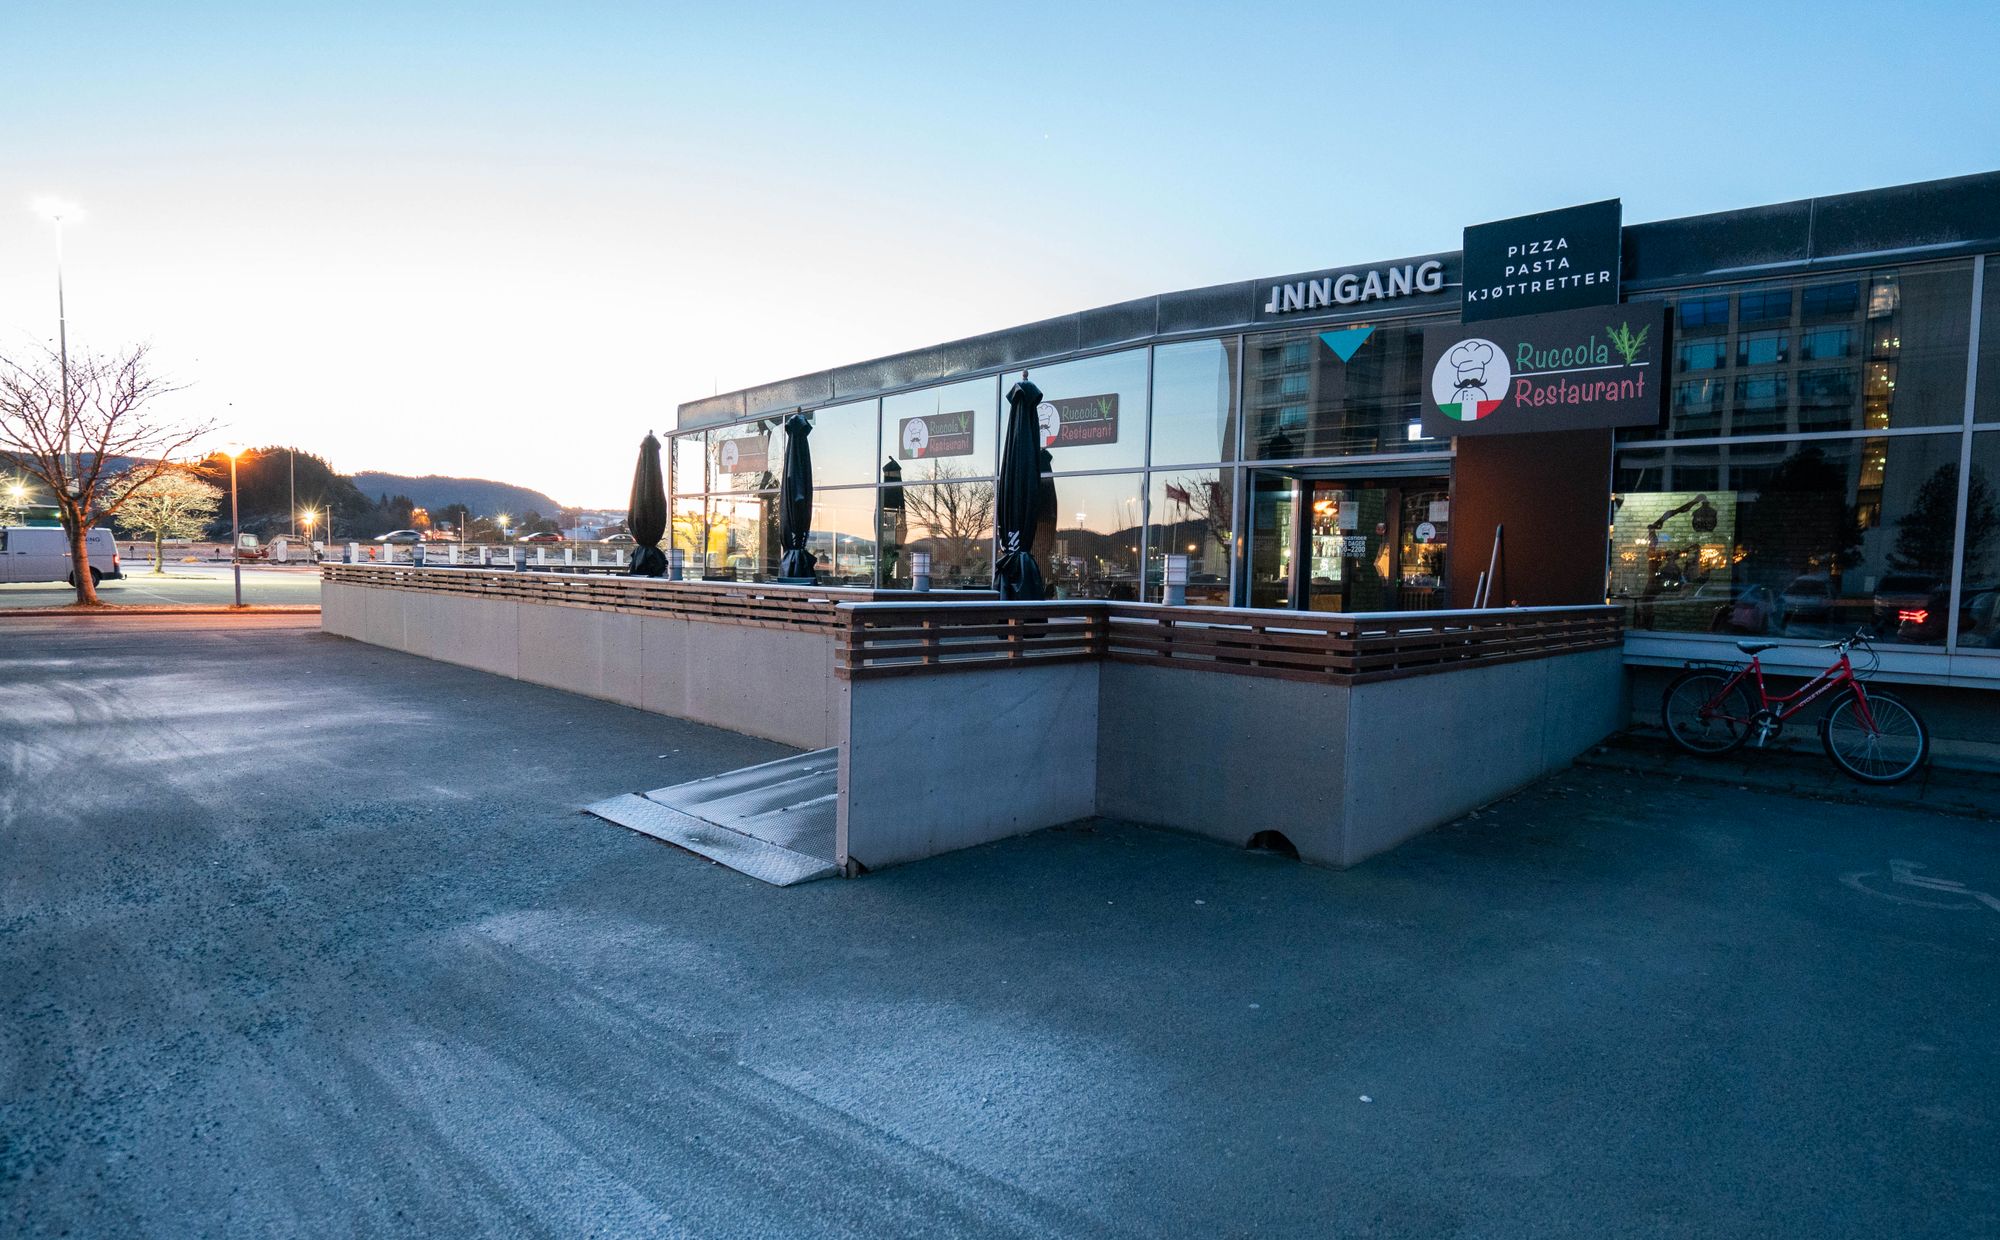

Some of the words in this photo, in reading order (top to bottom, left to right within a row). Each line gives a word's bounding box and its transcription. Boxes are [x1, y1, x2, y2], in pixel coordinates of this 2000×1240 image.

[1508, 237, 1568, 258] PIZZA
[1505, 257, 1570, 277] PASTA
[1270, 260, 1443, 313] INNGANG
[1468, 271, 1610, 302] KJØTTRETTER
[1516, 335, 1608, 371] Ruccola
[1515, 371, 1645, 407] Restaurant
[1062, 403, 1098, 421] Ruccola
[930, 420, 959, 434] Ruccola
[1061, 422, 1112, 441] Restaurant
[929, 437, 969, 452] Restaurant
